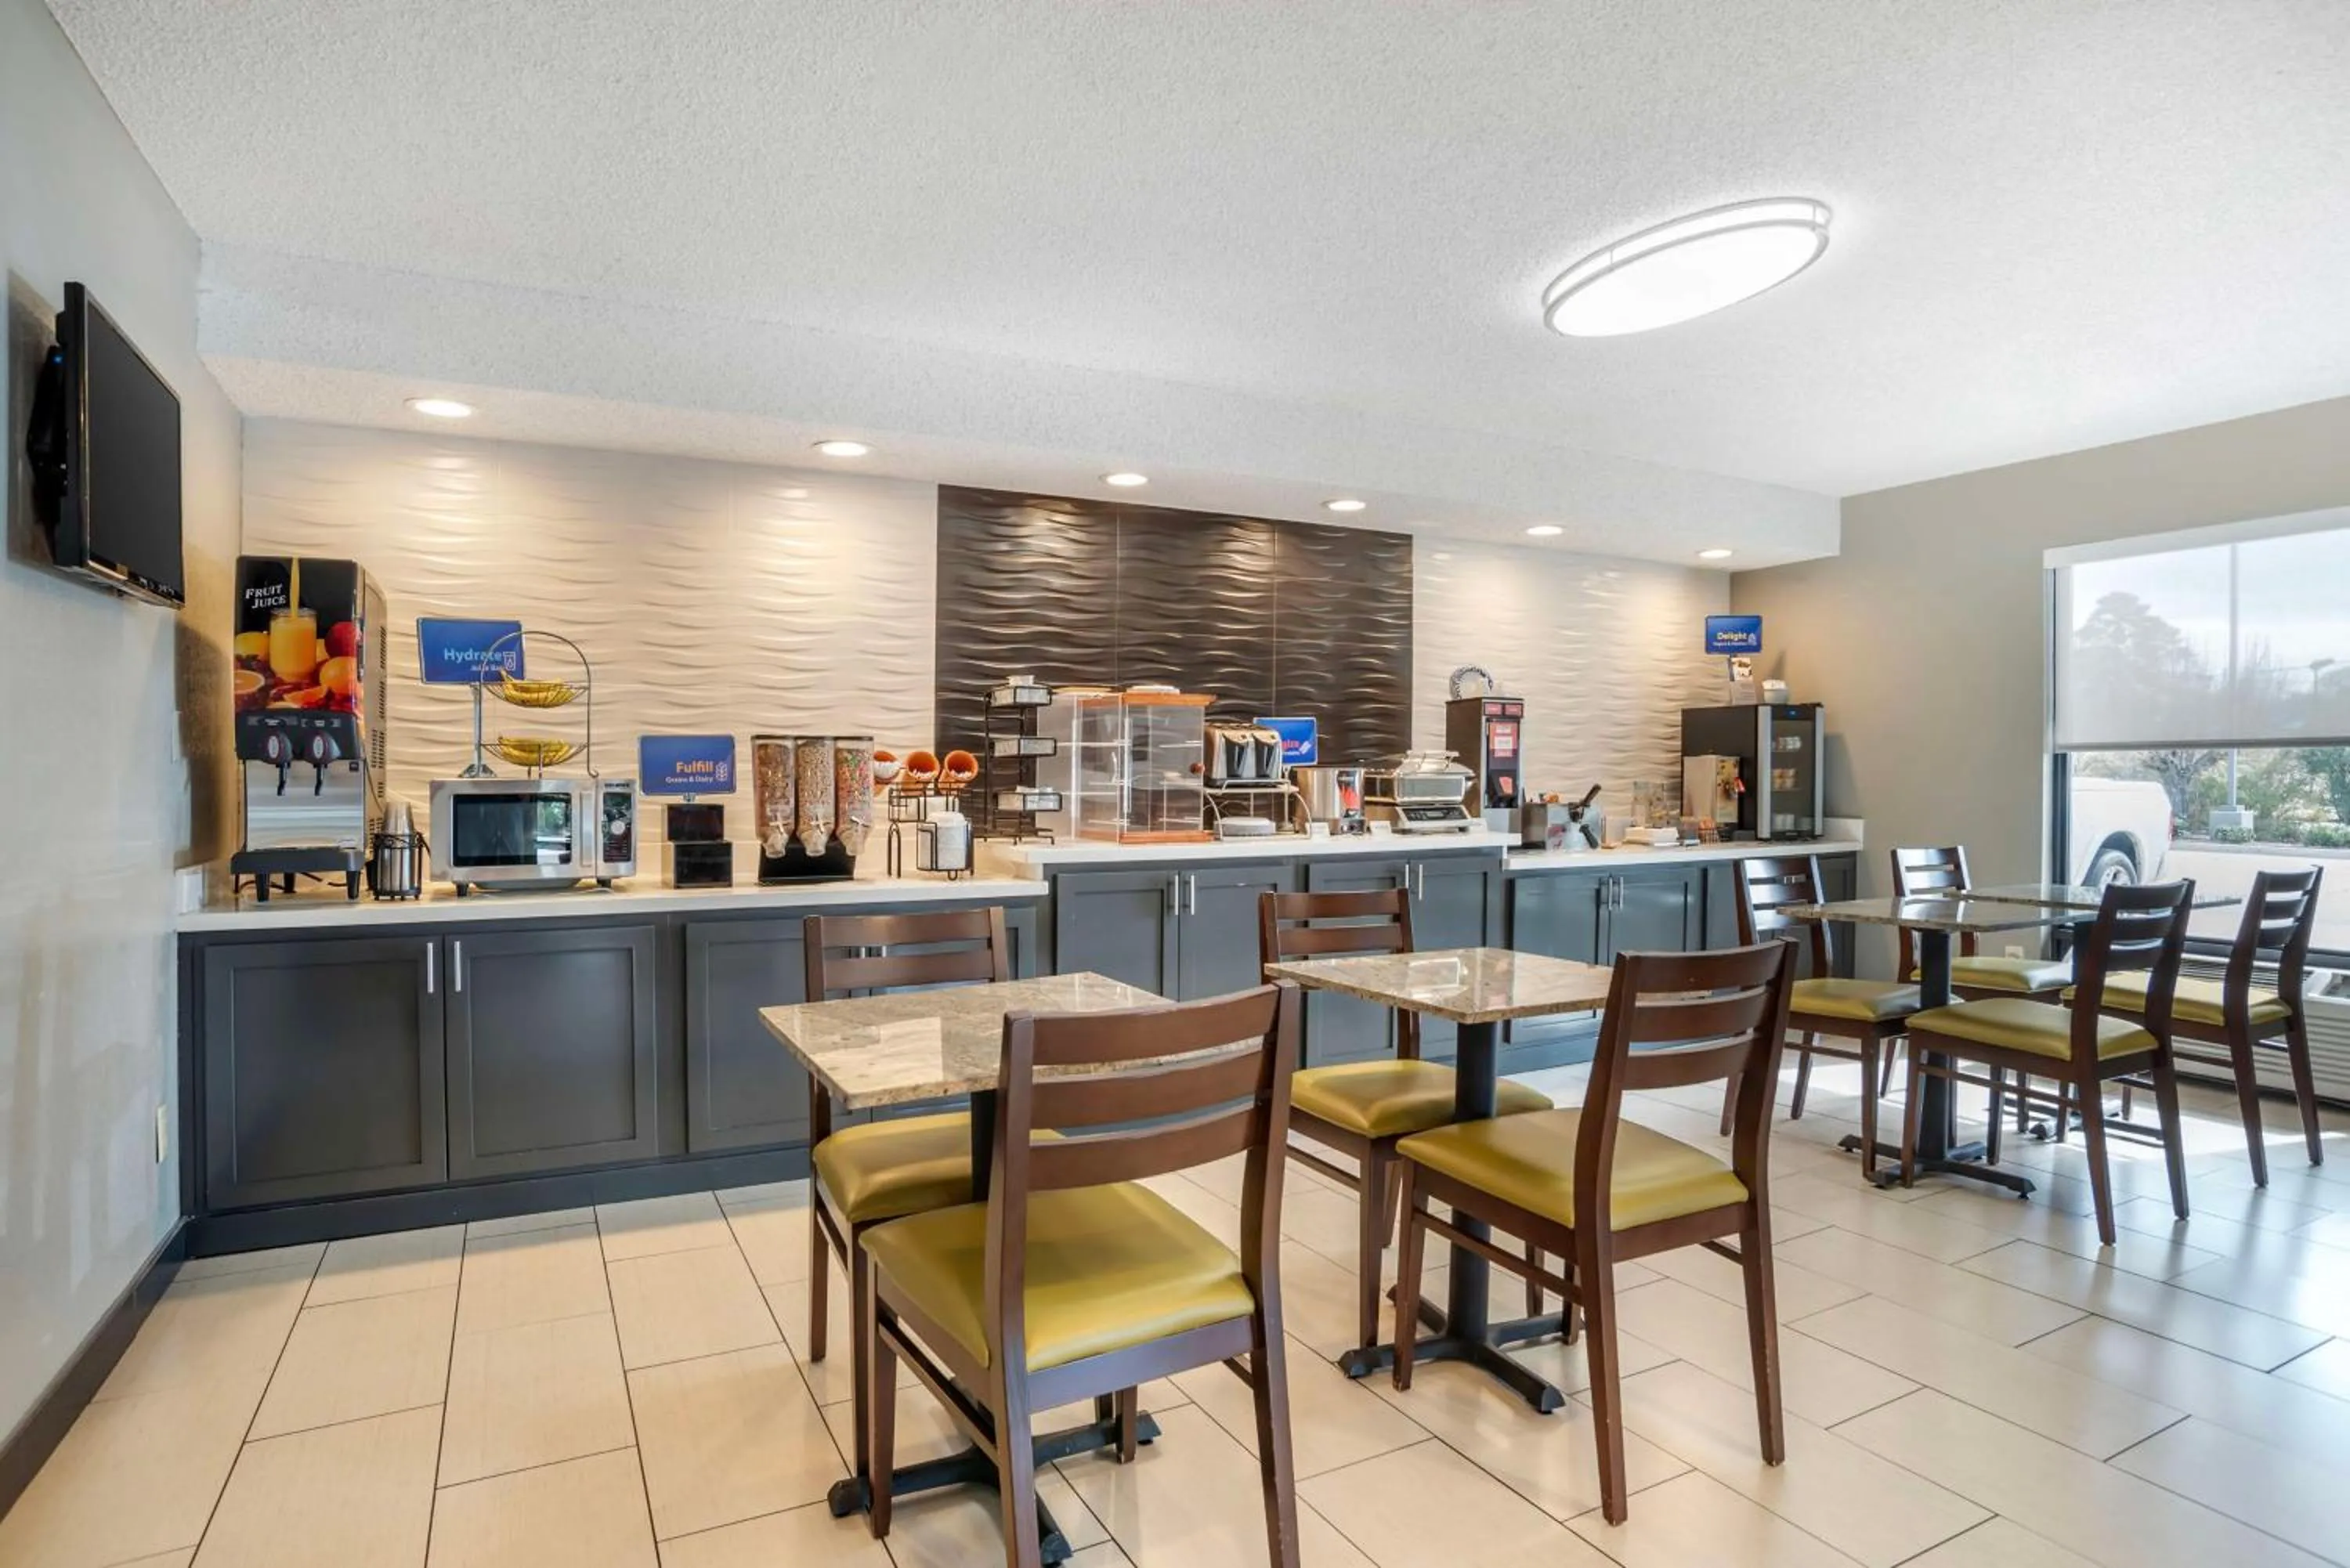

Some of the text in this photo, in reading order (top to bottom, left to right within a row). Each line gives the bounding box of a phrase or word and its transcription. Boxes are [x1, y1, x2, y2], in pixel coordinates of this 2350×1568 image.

[245, 583, 283, 599] FRUIT
[251, 594, 287, 609] JUICE
[676, 760, 714, 774] Fulfill
